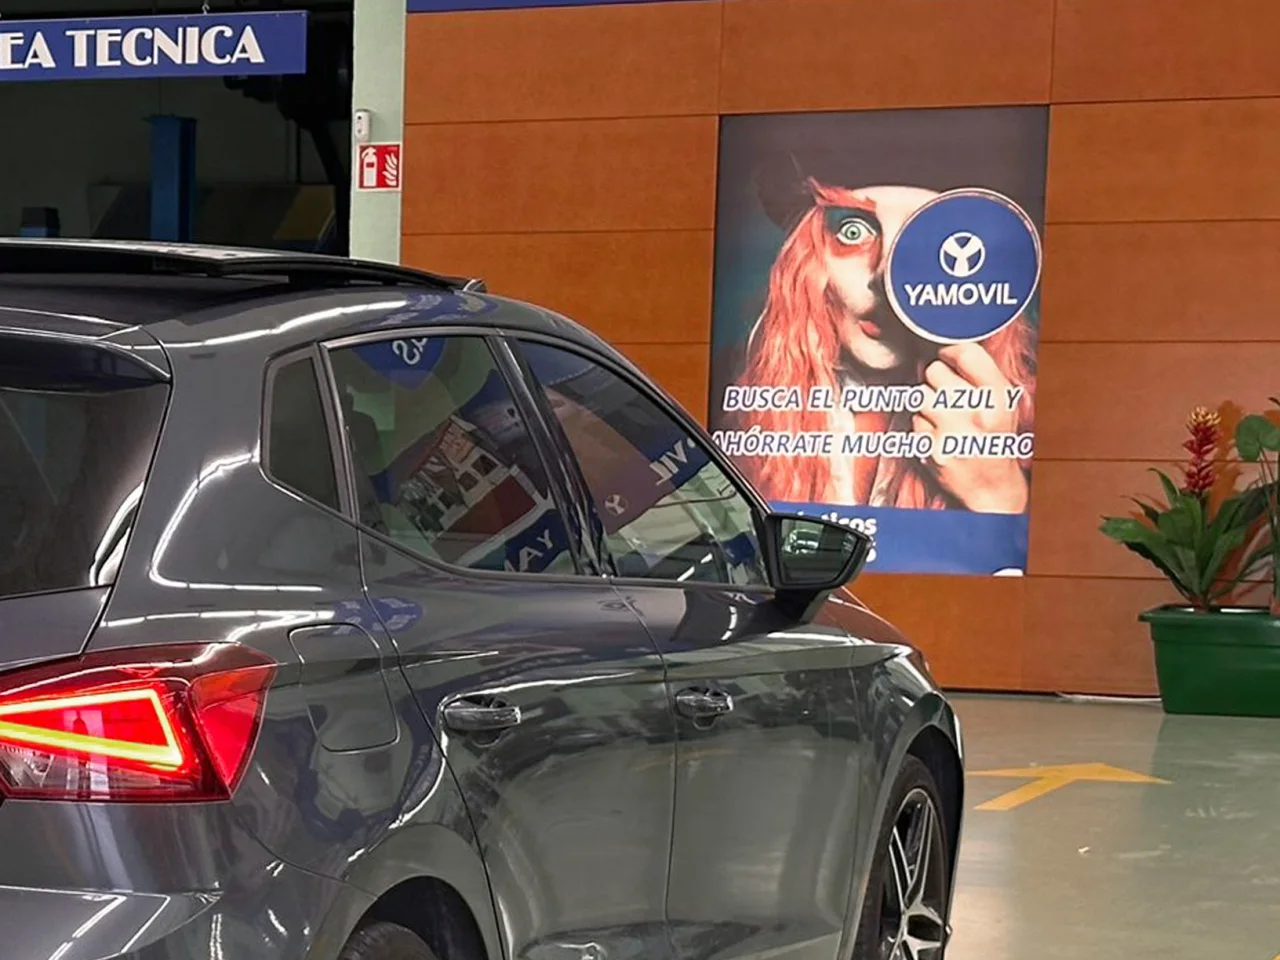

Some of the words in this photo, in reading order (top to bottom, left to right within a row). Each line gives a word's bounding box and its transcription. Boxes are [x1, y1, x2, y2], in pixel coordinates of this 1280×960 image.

[65, 25, 265, 67] TECNICA
[904, 283, 1018, 306] YAMOVIL
[723, 386, 801, 411] BUSCA
[809, 387, 834, 410] EL
[842, 387, 925, 411] PUNTO
[933, 387, 996, 411] AZUL
[1005, 387, 1023, 411] Y
[711, 427, 834, 454] AHÓRRATE
[841, 432, 933, 457] MUCHO
[942, 434, 1035, 458] DINERO
